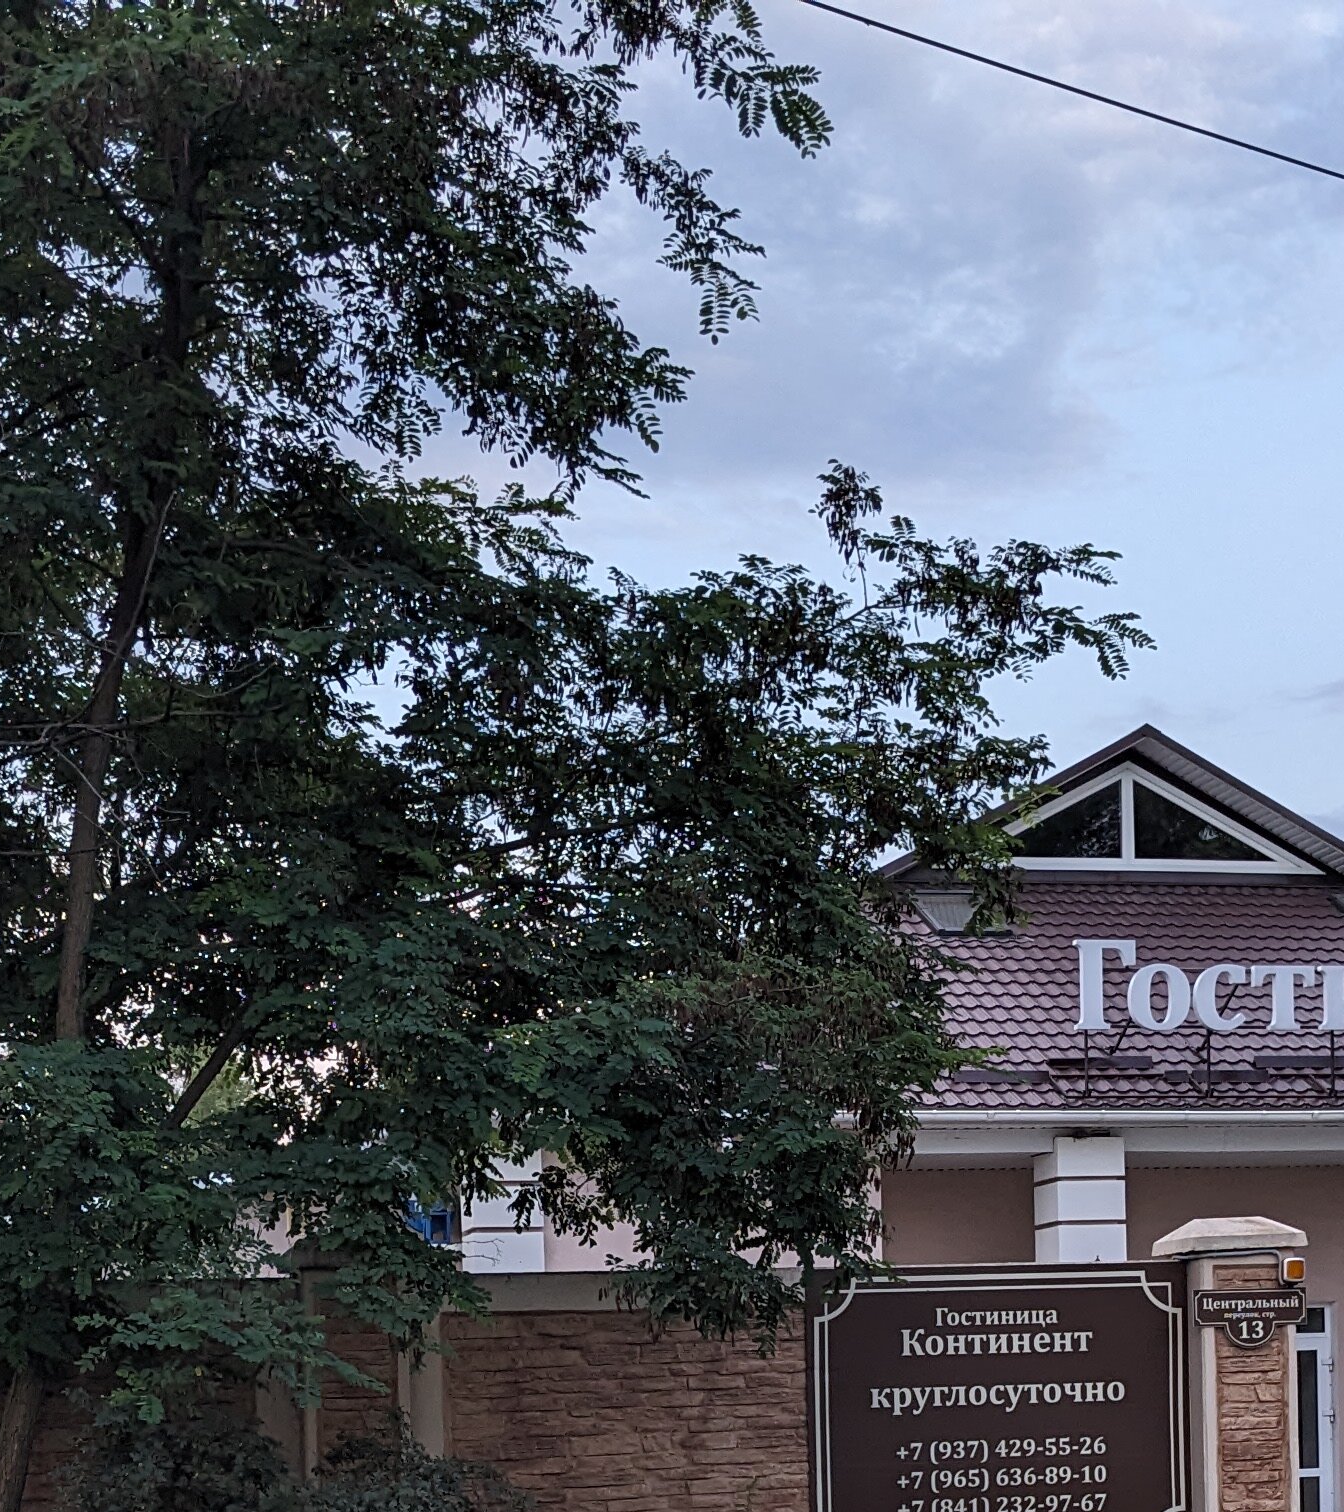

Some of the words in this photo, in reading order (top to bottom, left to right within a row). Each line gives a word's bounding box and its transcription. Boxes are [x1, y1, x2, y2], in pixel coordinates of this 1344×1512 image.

[935, 1307, 1058, 1328] Гостиница
[1202, 1295, 1299, 1312] Центральный
[900, 1328, 1093, 1357] Континент
[1238, 1320, 1264, 1339] 13
[870, 1381, 1126, 1416] круглосуточно
[896, 1442, 923, 1461] +7
[930, 1439, 989, 1465] (937)
[994, 1436, 1106, 1458] 429-55-26
[897, 1471, 924, 1489] +7
[930, 1468, 990, 1494] (965)
[996, 1464, 1107, 1487] 636-89-10
